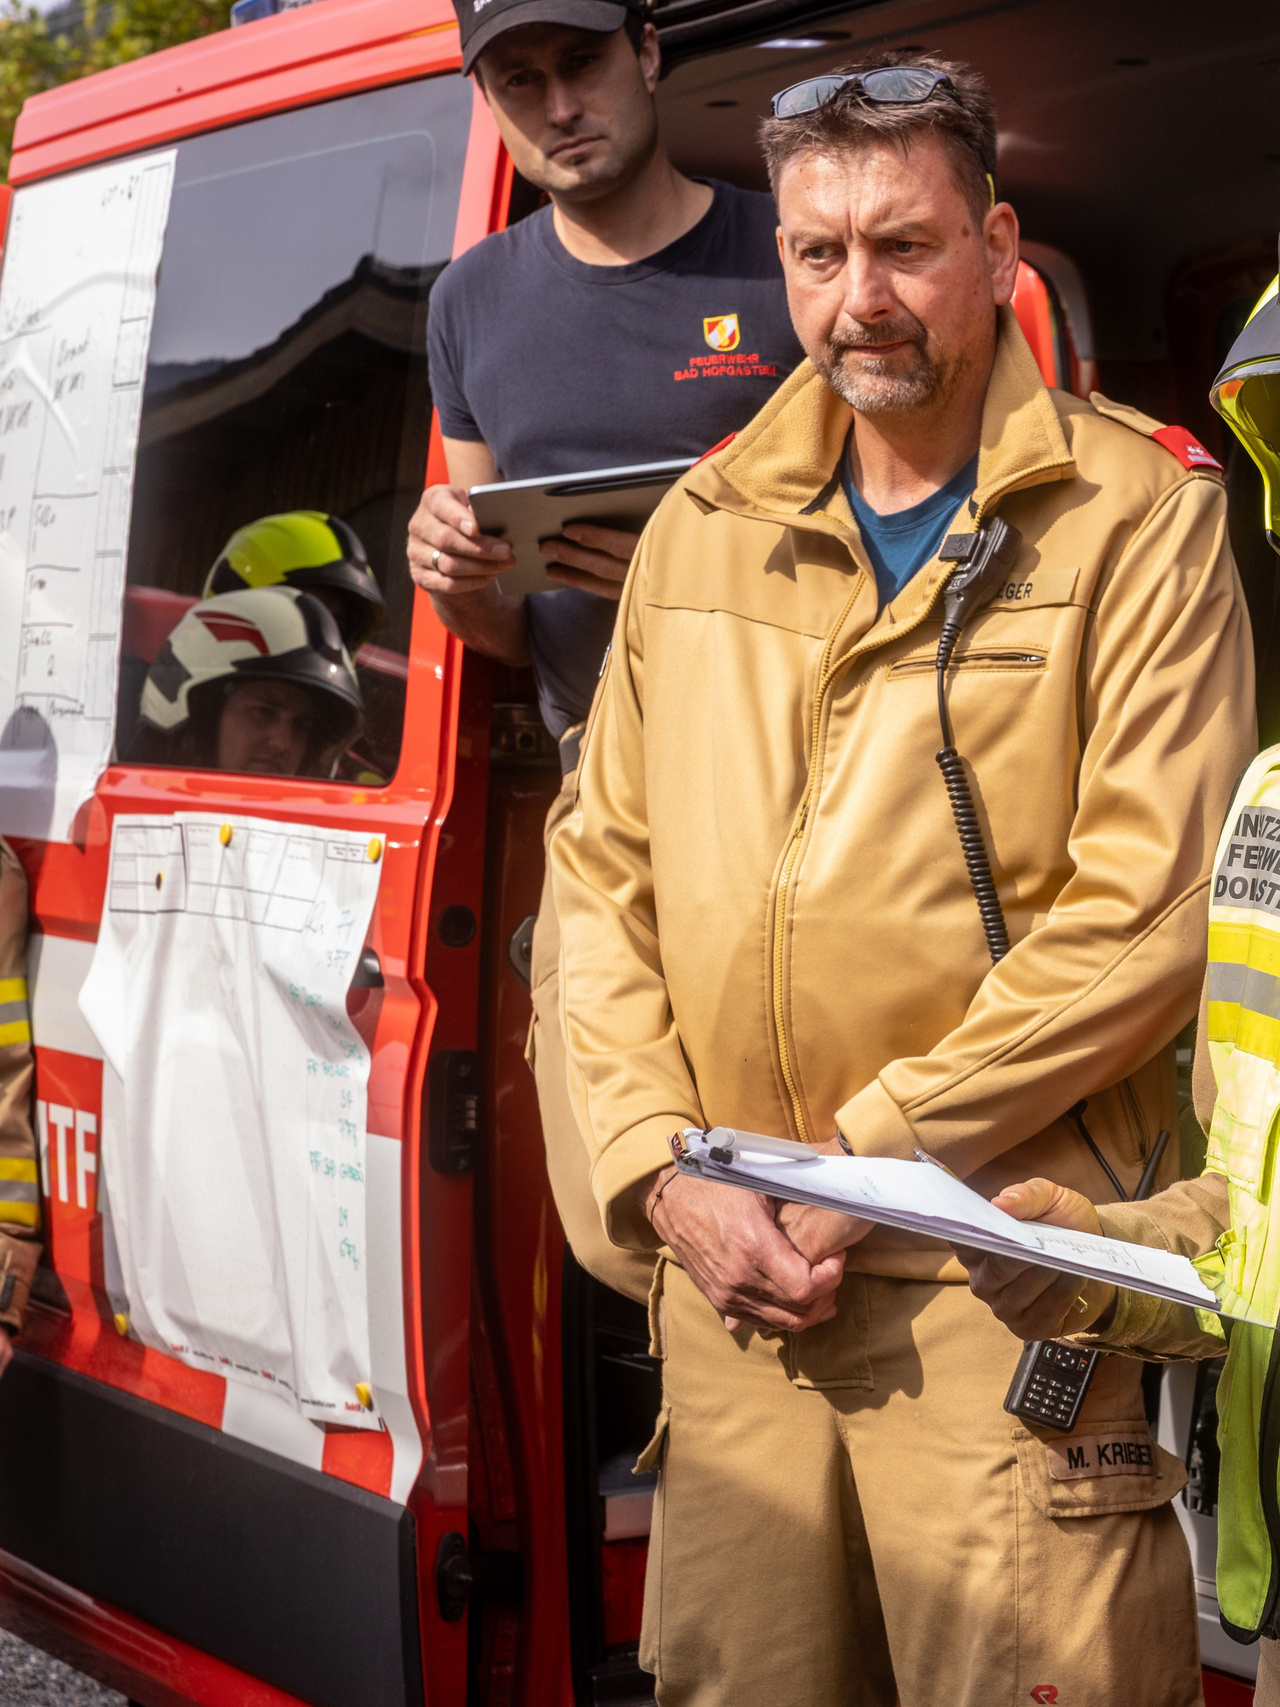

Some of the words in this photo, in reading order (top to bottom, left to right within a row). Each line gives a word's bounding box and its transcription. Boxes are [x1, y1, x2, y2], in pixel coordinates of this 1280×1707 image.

[689, 353, 759, 367] FEUERWEHR
[673, 368, 699, 381] BAD
[1066, 1445, 1090, 1470] M.
